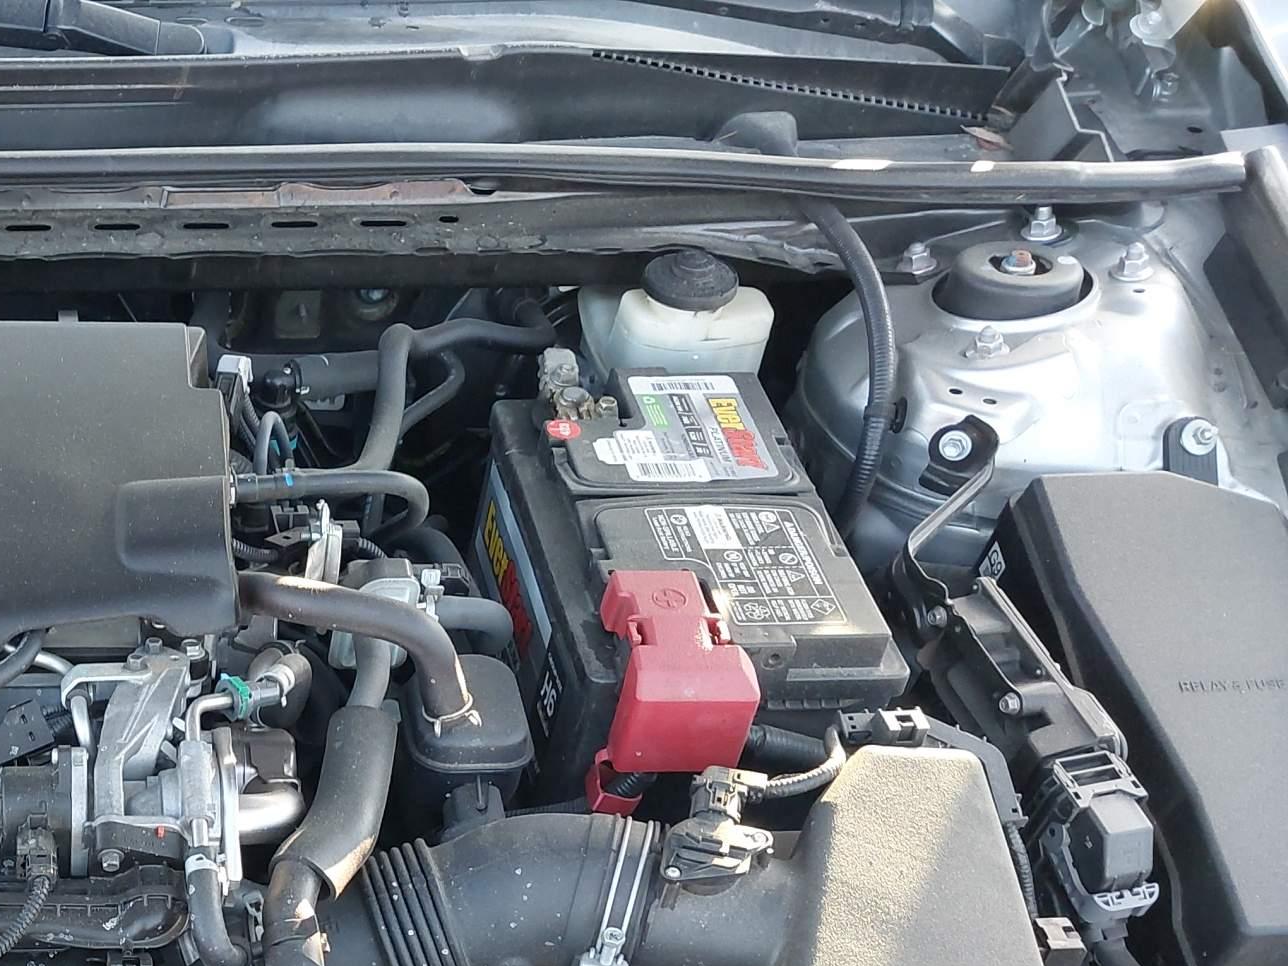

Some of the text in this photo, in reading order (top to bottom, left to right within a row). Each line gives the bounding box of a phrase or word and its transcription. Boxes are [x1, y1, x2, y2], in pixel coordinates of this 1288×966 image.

[708, 398, 769, 470] EverStart
[711, 427, 732, 463] PLATINUM
[540, 670, 557, 718] H6
